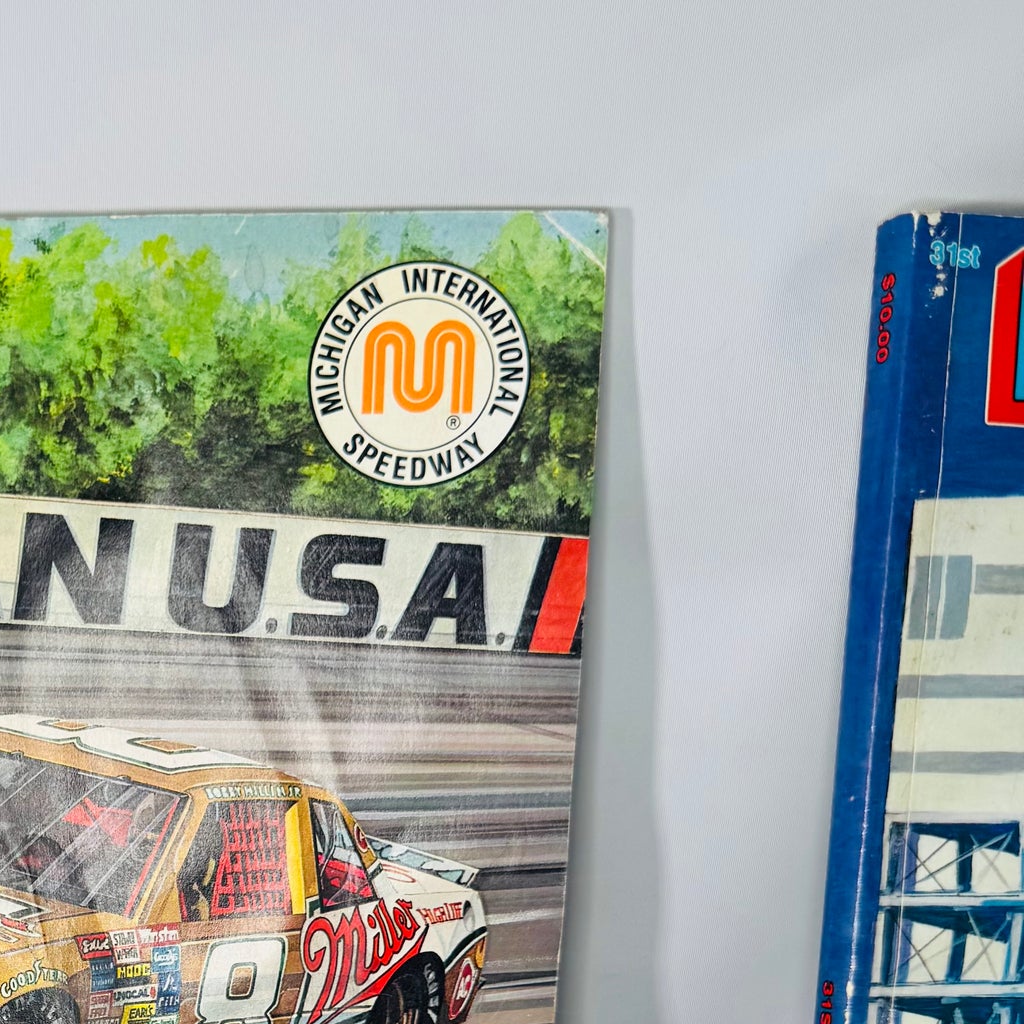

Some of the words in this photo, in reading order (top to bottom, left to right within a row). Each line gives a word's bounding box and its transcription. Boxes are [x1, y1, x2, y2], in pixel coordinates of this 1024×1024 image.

[929, 240, 981, 268] 31st
[314, 282, 384, 416] MICHIGAN
[401, 268, 524, 417] INTERNATIONAL
[342, 432, 485, 481] SPEEDWAY
[166, 521, 507, 648] U.S.A.
[0, 957, 69, 998] GOODYEAR
